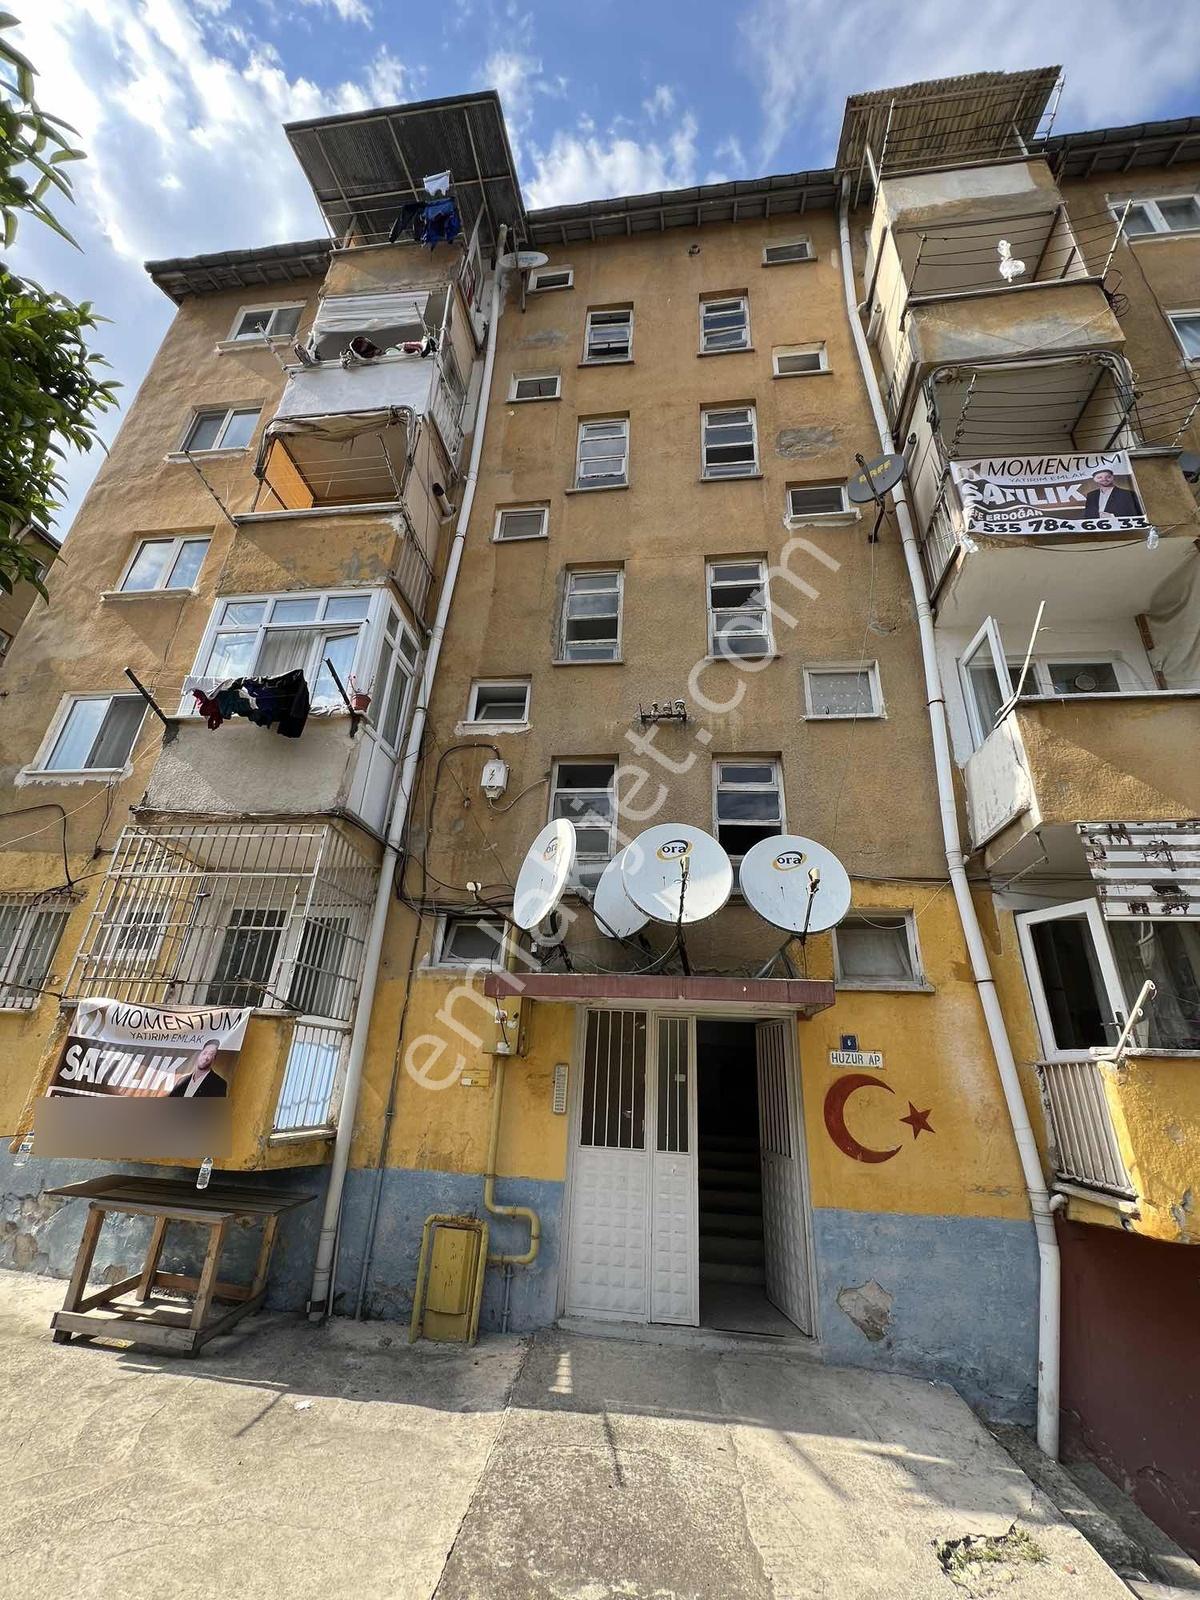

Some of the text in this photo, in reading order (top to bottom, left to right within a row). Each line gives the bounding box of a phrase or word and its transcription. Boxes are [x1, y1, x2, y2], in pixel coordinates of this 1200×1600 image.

[988, 453, 1121, 477] MOMENTUM
[1050, 471, 1087, 482] EMLAK
[986, 507, 1043, 521] ERDOĞAN
[983, 522, 1022, 533] 535
[1028, 519, 1075, 532] 784
[1081, 518, 1112, 531] 66
[1119, 517, 1148, 529] 33
[662, 842, 688, 856] ora
[776, 855, 803, 867] ora
[111, 1007, 242, 1031] MOMENTUM
[129, 1031, 204, 1044] YATIRIM EMLAK
[831, 1052, 881, 1066] HUZUR AP
[59, 1044, 188, 1091] SATILIK
